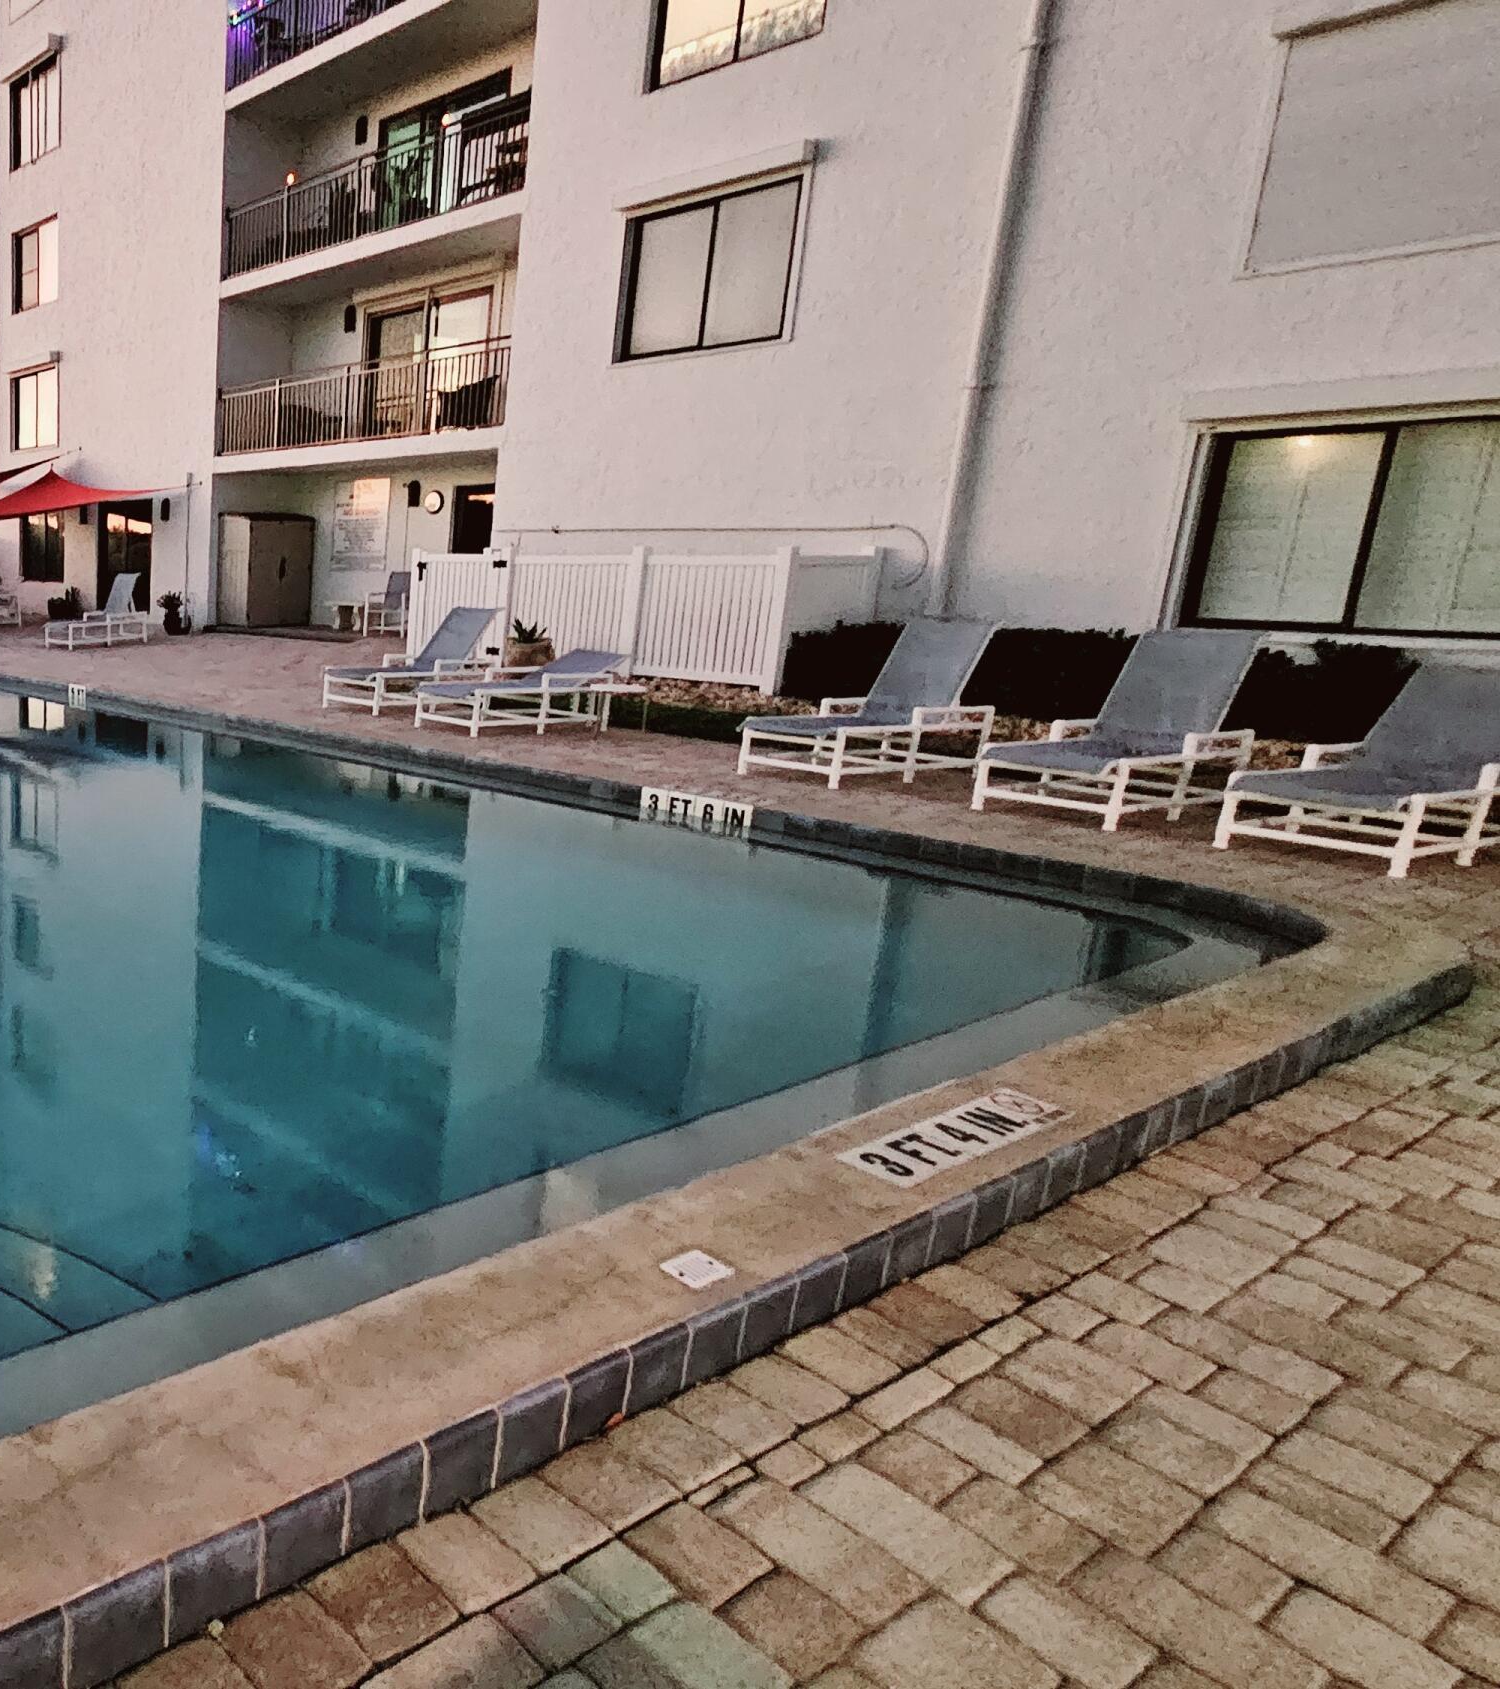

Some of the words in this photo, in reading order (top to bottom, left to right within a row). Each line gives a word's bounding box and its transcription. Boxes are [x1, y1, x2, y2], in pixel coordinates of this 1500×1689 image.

[669, 796, 692, 818] FT
[724, 806, 746, 829] IN
[859, 1152, 915, 1177] 3
[934, 1122, 989, 1145] 4
